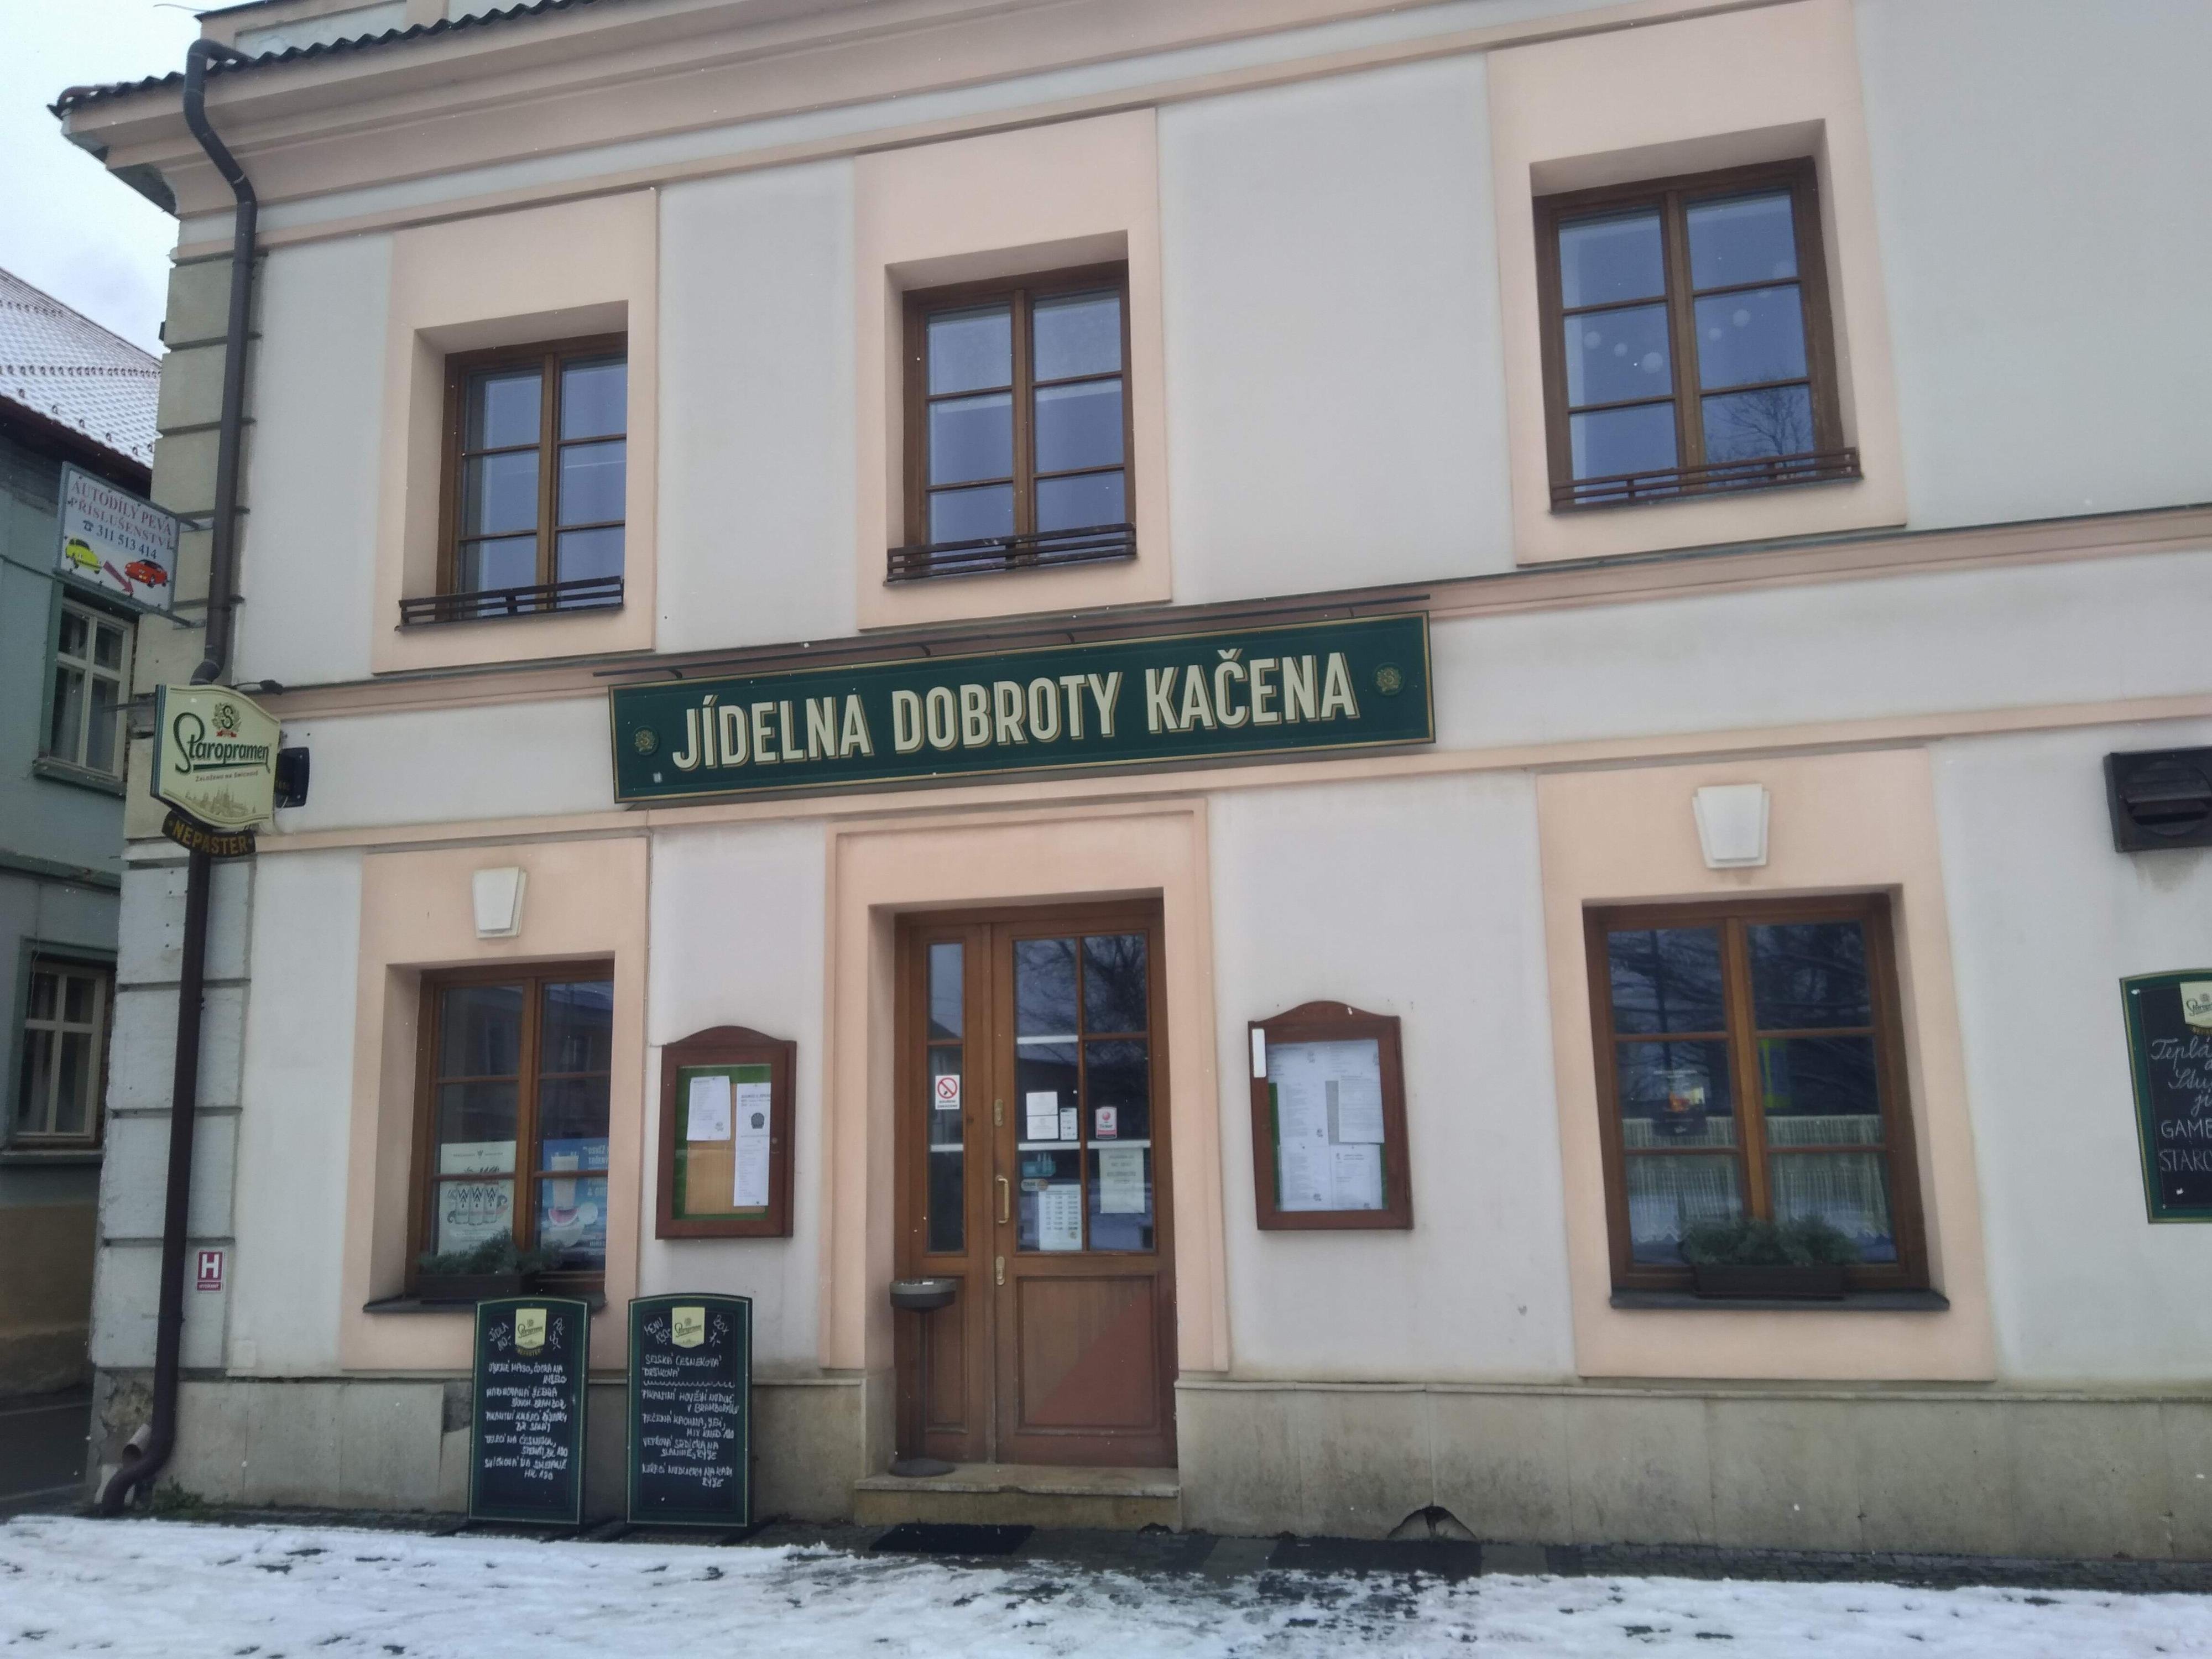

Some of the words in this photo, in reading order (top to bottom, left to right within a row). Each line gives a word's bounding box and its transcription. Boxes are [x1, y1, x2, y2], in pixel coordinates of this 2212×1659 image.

[72, 480, 138, 519] AUTODÍLY
[142, 513, 172, 535] PEVA
[97, 524, 114, 541] 311
[118, 535, 136, 551] 513
[139, 544, 156, 560] 414
[671, 695, 874, 770] JÍDELNA
[894, 671, 1124, 754] DOBROTY
[1145, 648, 1360, 732] KAČENA
[173, 712, 271, 774] Staropramen
[172, 818, 248, 854] NEPASTER
[201, 1253, 220, 1279] H
[553, 1364, 562, 1373] NA
[507, 1435, 516, 1443] NA
[708, 1441, 718, 1450] NA
[520, 1455, 530, 1467] NA
